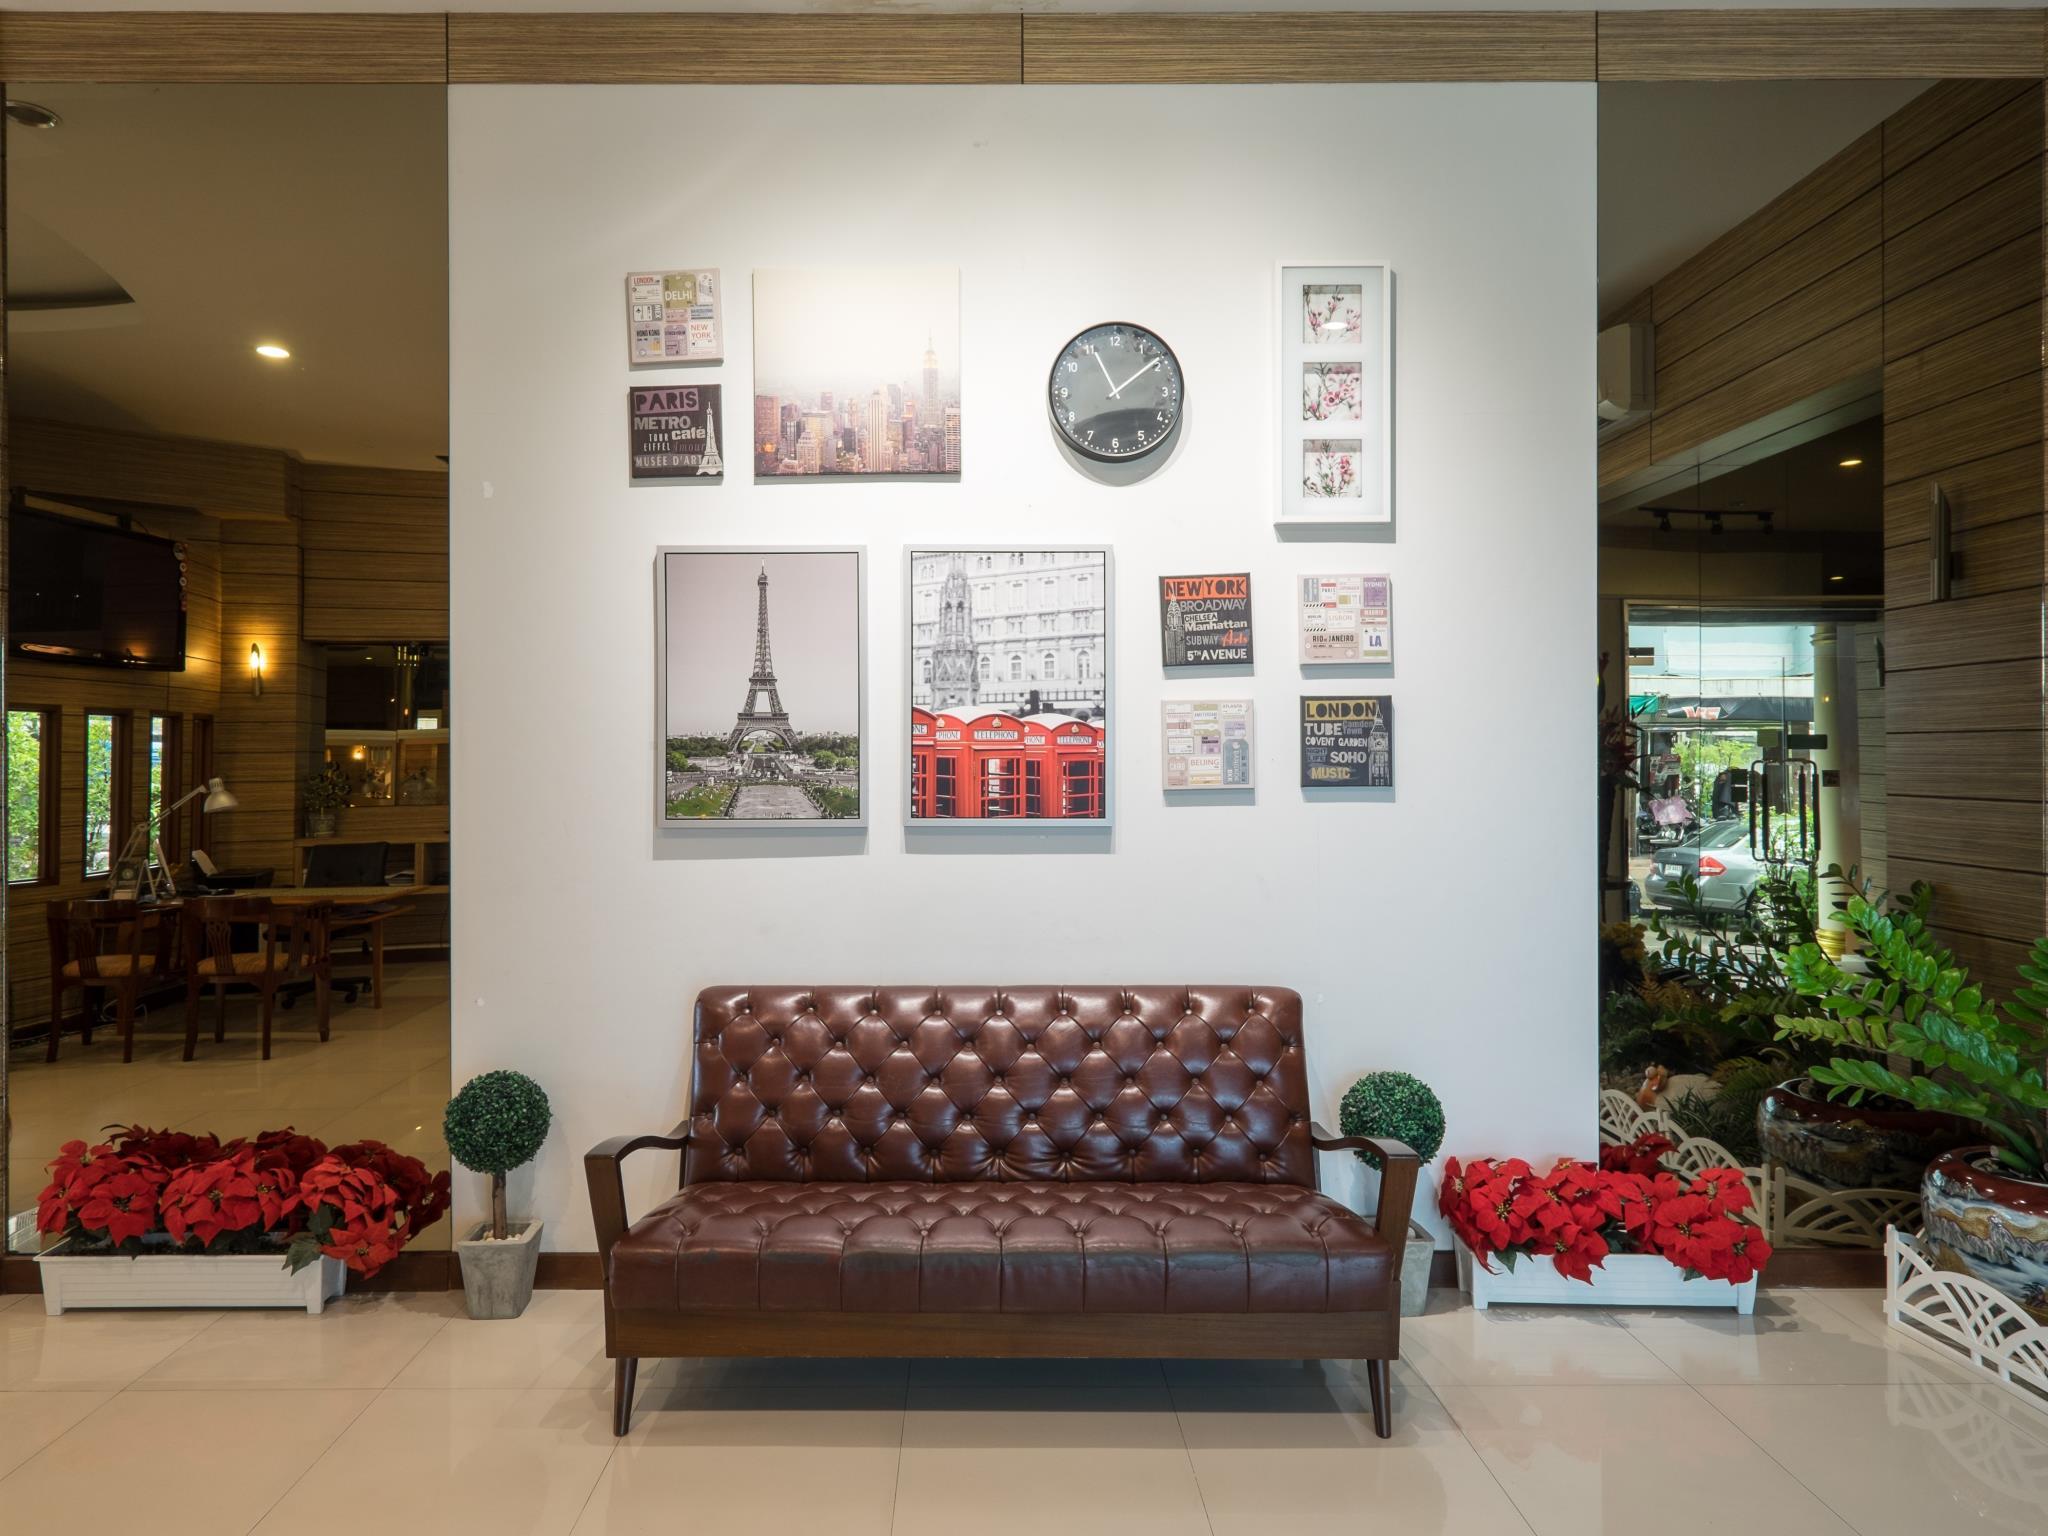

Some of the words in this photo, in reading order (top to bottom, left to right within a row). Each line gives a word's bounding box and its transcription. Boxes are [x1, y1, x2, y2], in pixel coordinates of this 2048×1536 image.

[664, 290, 692, 300] DELHI
[1110, 336, 1120, 346] 12
[1085, 345, 1094, 354] 11
[1067, 362, 1078, 372] 10
[1155, 362, 1161, 372] 2
[1061, 388, 1068, 397] 9
[1162, 387, 1168, 397] 3
[635, 391, 698, 411] PARIS
[1069, 411, 1075, 421] 8
[1156, 411, 1163, 421] 4
[634, 416, 691, 430] METRO
[649, 433, 668, 442] TOUR
[671, 425, 706, 440] café
[1087, 430, 1094, 440] 7
[1137, 431, 1144, 440] 5
[643, 442, 670, 451] EIFFEL
[1112, 438, 1119, 448] 6
[672, 454, 702, 466] D'ART
[1165, 581, 1202, 597] NEW
[1204, 579, 1246, 595] YORK
[1180, 599, 1246, 612] BROADWAY
[1184, 613, 1217, 622] CHELSEA
[1185, 620, 1247, 632] Manhattan
[1186, 635, 1219, 646] SUBWAY
[1369, 635, 1382, 647] LA
[1201, 649, 1247, 660] AVENUE
[1306, 702, 1376, 718] LONDON
[1304, 722, 1342, 735] TUBE
[976, 731, 1016, 740] TELEPHONE
[1305, 737, 1335, 746] COVENT
[1338, 737, 1367, 747] GARDEN
[1330, 751, 1367, 763] SOHO
[1311, 767, 1350, 779] MUSIC
